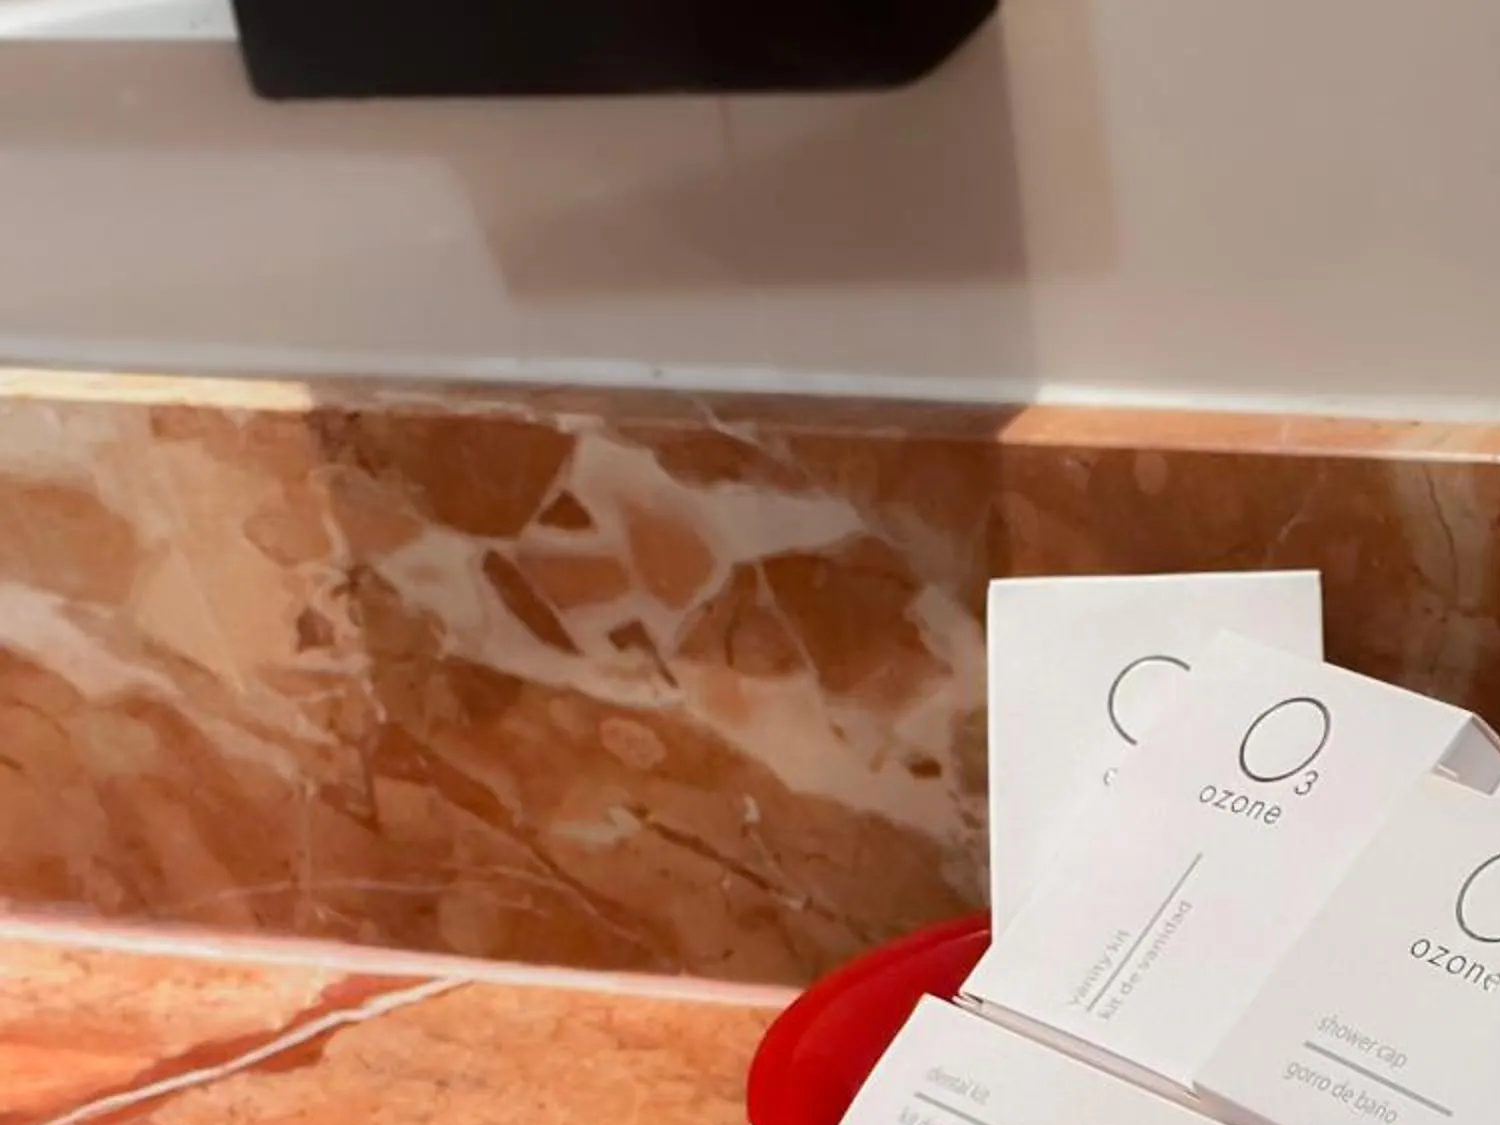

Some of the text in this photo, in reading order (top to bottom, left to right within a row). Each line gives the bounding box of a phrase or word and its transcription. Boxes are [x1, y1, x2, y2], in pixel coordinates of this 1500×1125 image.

[1199, 784, 1282, 826] ozone
[1317, 1014, 1408, 1070] shower cap
[1283, 1061, 1331, 1092] gorro
